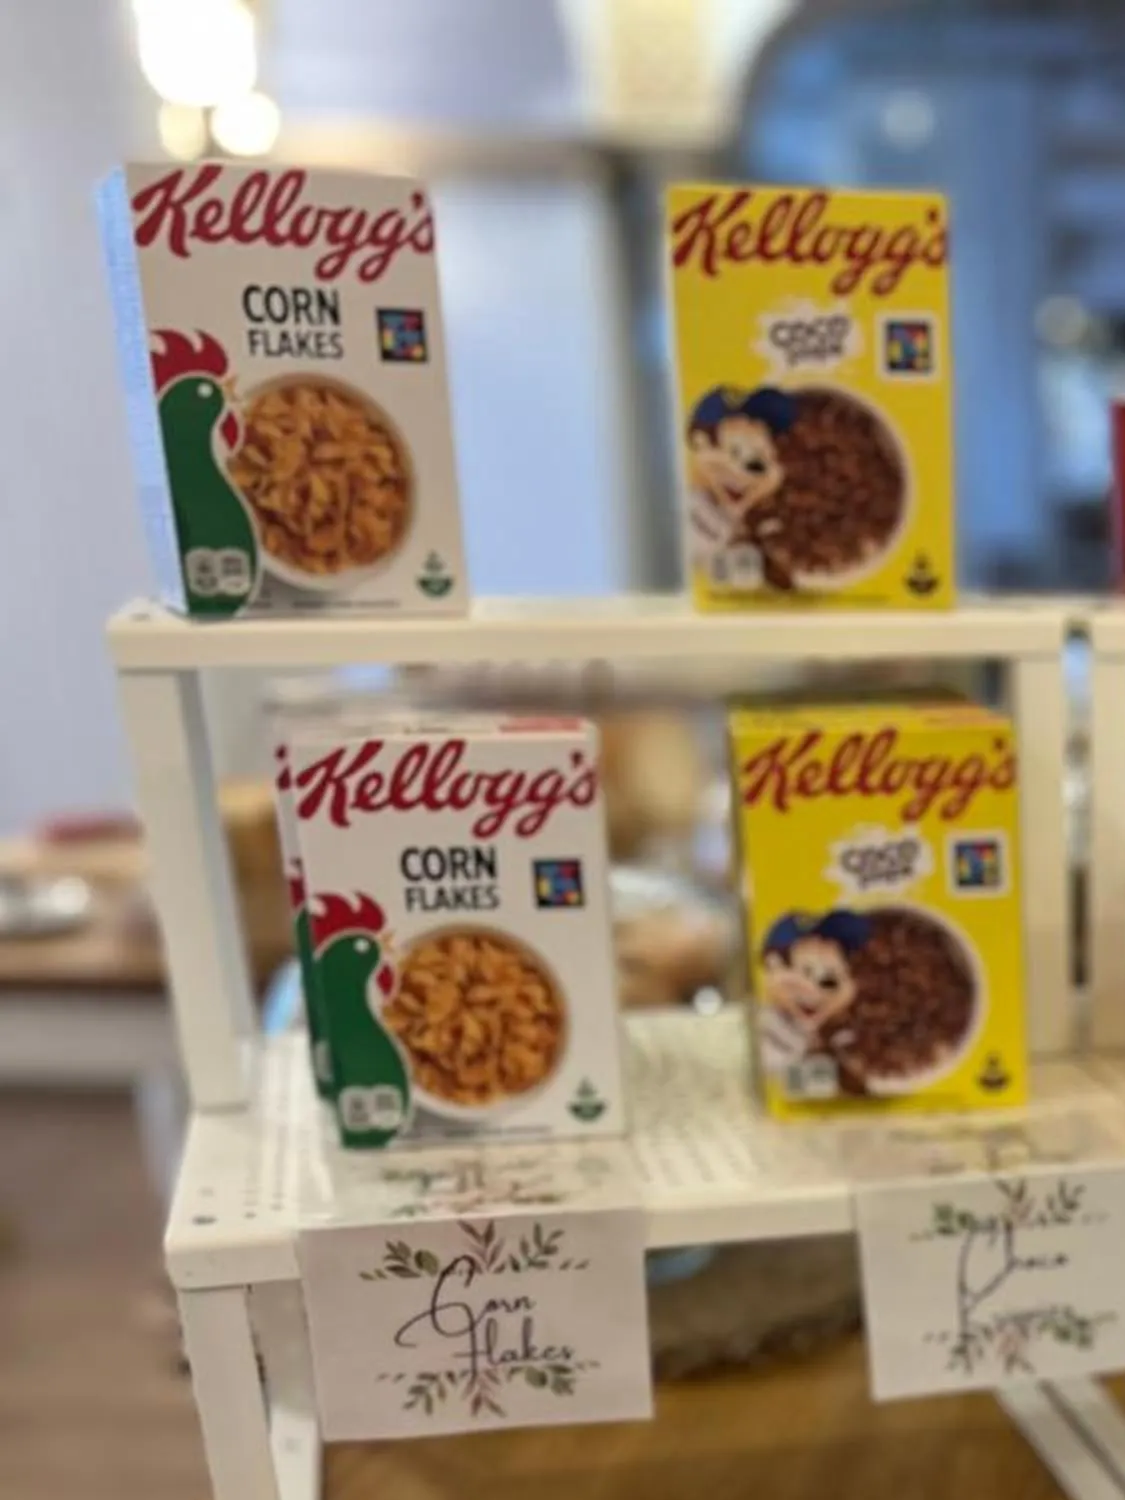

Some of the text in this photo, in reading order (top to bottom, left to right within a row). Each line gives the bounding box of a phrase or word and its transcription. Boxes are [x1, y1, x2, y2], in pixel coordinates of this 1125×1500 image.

[132, 164, 435, 283] Kellogg's
[672, 190, 948, 296] Kellogg's
[242, 284, 341, 326] CORN
[248, 329, 345, 360] FLAKES
[296, 740, 600, 838] Kellogg's
[743, 728, 1017, 822] Kellogg's
[400, 846, 498, 882] CORN
[405, 885, 500, 912] FLAKES
